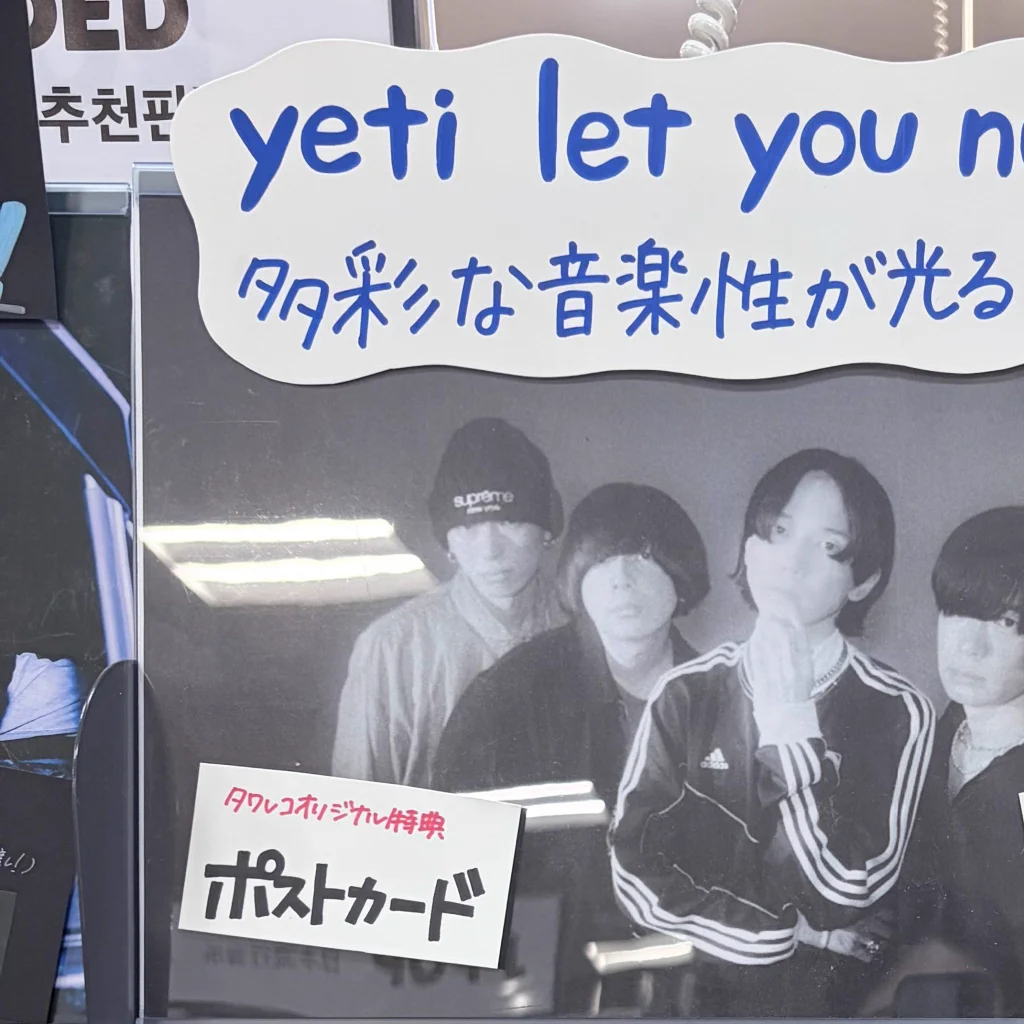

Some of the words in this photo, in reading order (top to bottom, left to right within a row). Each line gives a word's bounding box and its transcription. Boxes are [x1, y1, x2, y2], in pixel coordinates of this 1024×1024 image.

[38, 85, 198, 143] 추천판
[229, 84, 457, 212] yeti
[538, 57, 692, 182] let
[734, 109, 919, 213] you
[204, 849, 486, 942] ポストカード
